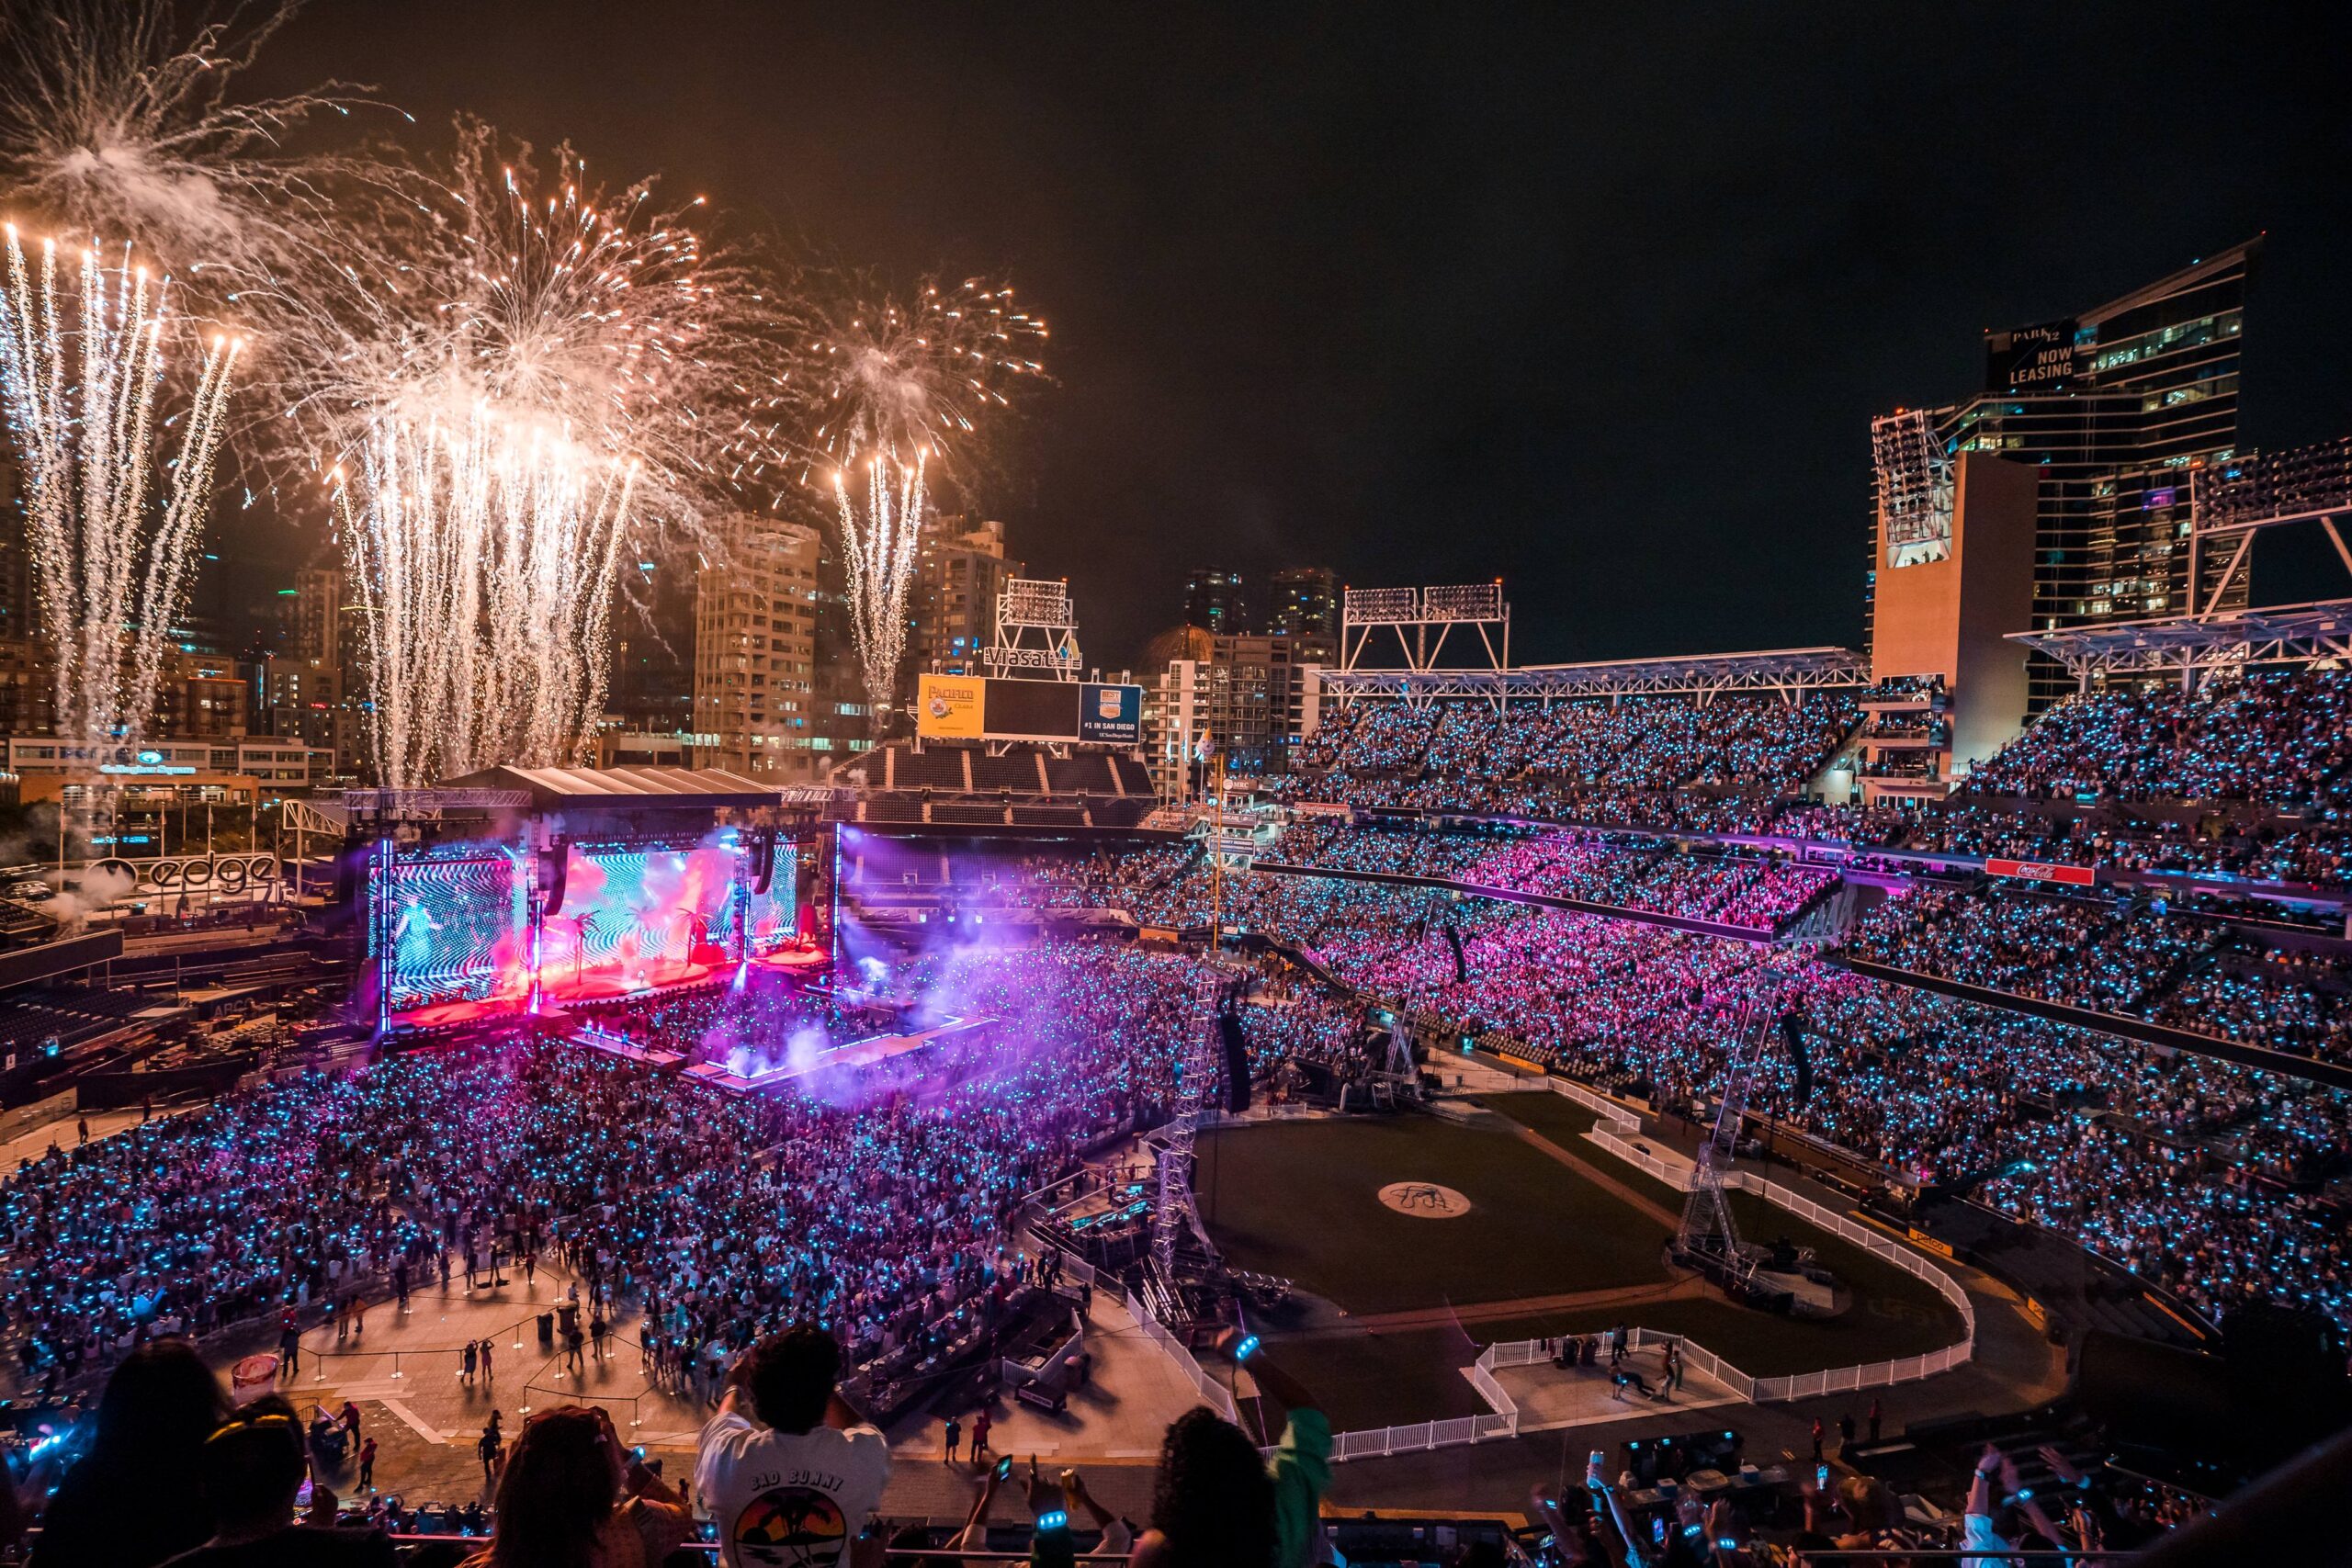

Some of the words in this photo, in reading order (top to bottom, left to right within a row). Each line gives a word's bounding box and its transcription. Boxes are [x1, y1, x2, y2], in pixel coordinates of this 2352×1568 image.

[2037, 346, 2073, 366] NOW
[2009, 362, 2073, 385] LEASING
[988, 648, 1053, 668] Viasat
[1102, 722, 1115, 730] SAN
[1116, 723, 1136, 731] DIEGO
[149, 850, 277, 896] edge
[2017, 863, 2056, 879] Coca-Cola
[1917, 1233, 1944, 1250] petco
[751, 1470, 781, 1492] BAD
[788, 1470, 844, 1493] BUNNY
